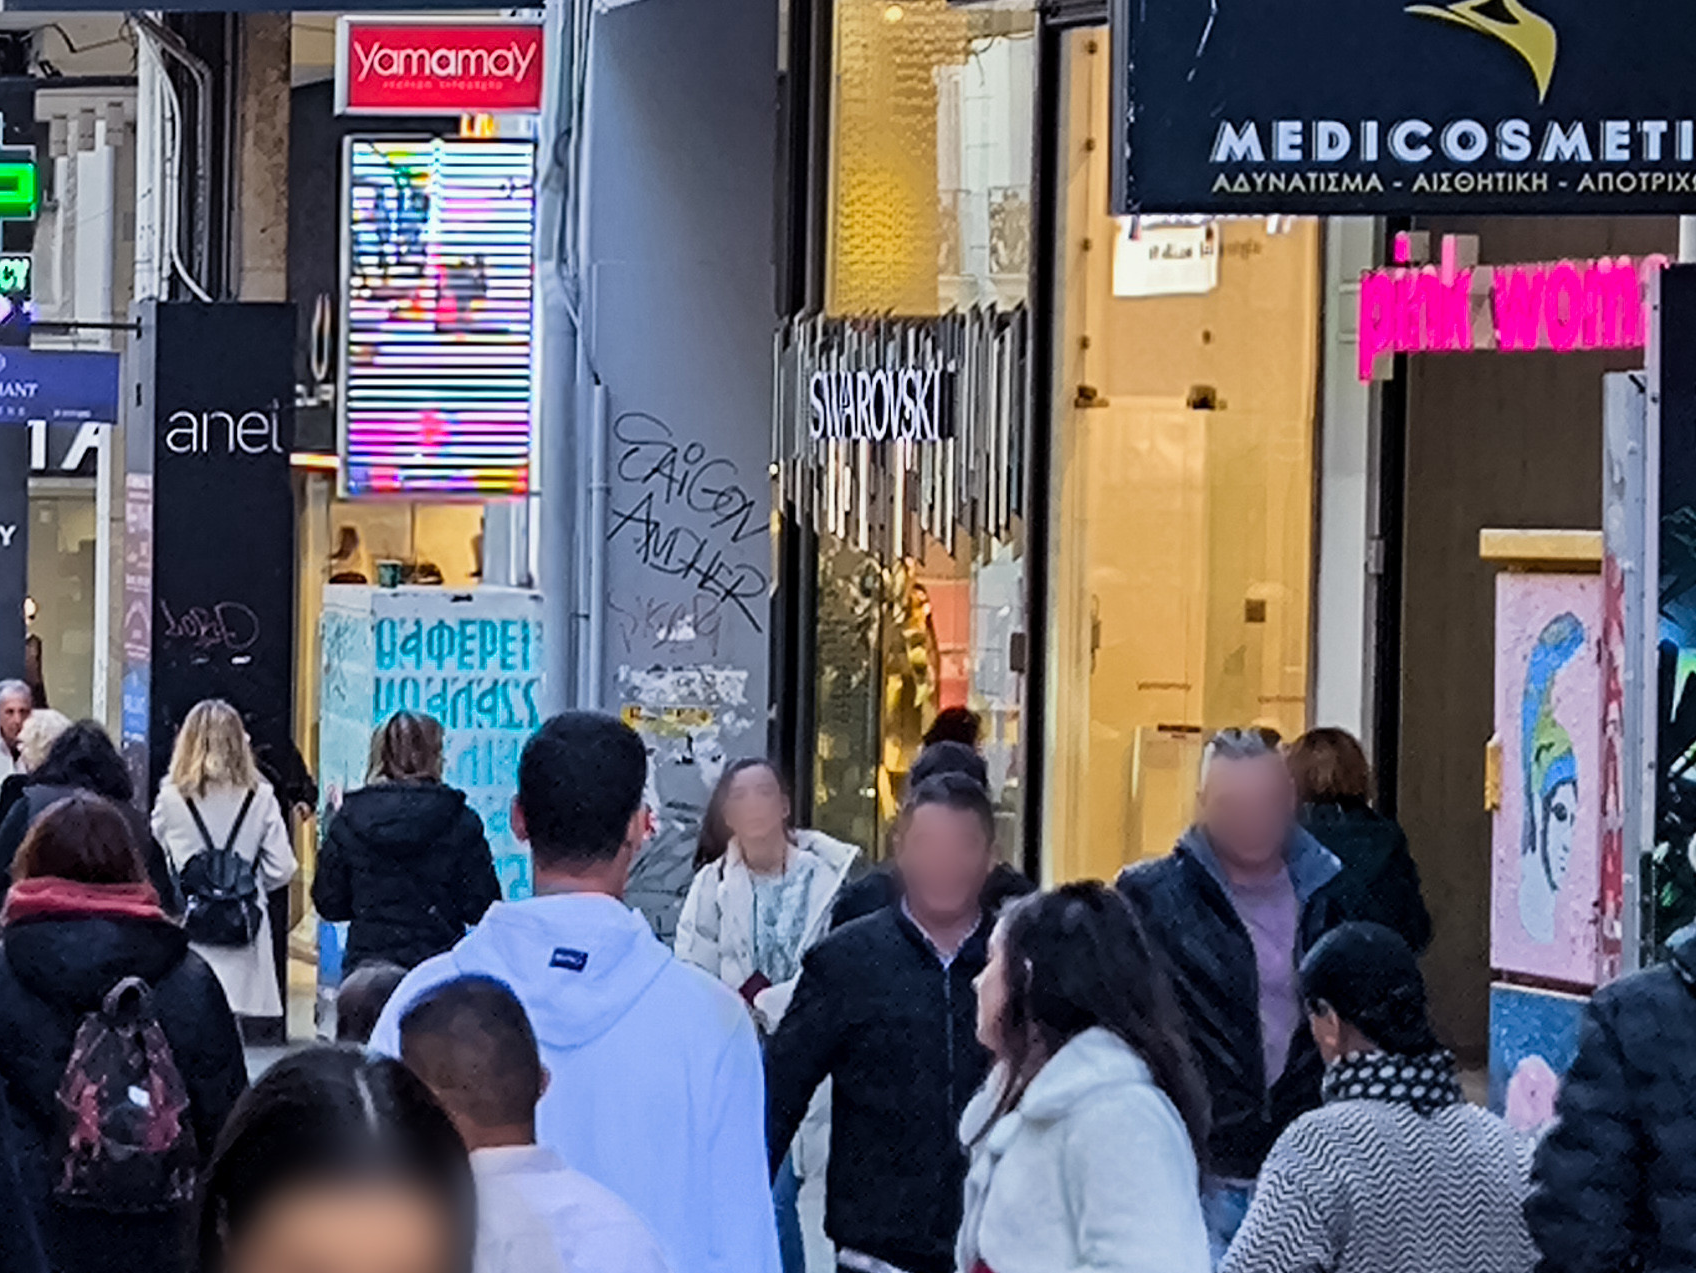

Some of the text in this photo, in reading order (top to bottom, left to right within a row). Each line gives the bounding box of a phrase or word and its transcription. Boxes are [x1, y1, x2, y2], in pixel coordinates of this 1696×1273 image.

[354, 40, 537, 83] yamamay
[1212, 172, 1696, 194] ΑΔΥΝΑΤΙΣΜΑ ΑΙΣΘΗΤΙΚΗ ΑΠΟΤΡΙΧ
[165, 400, 284, 453] anel
[809, 367, 944, 442] SWAROVSKI
